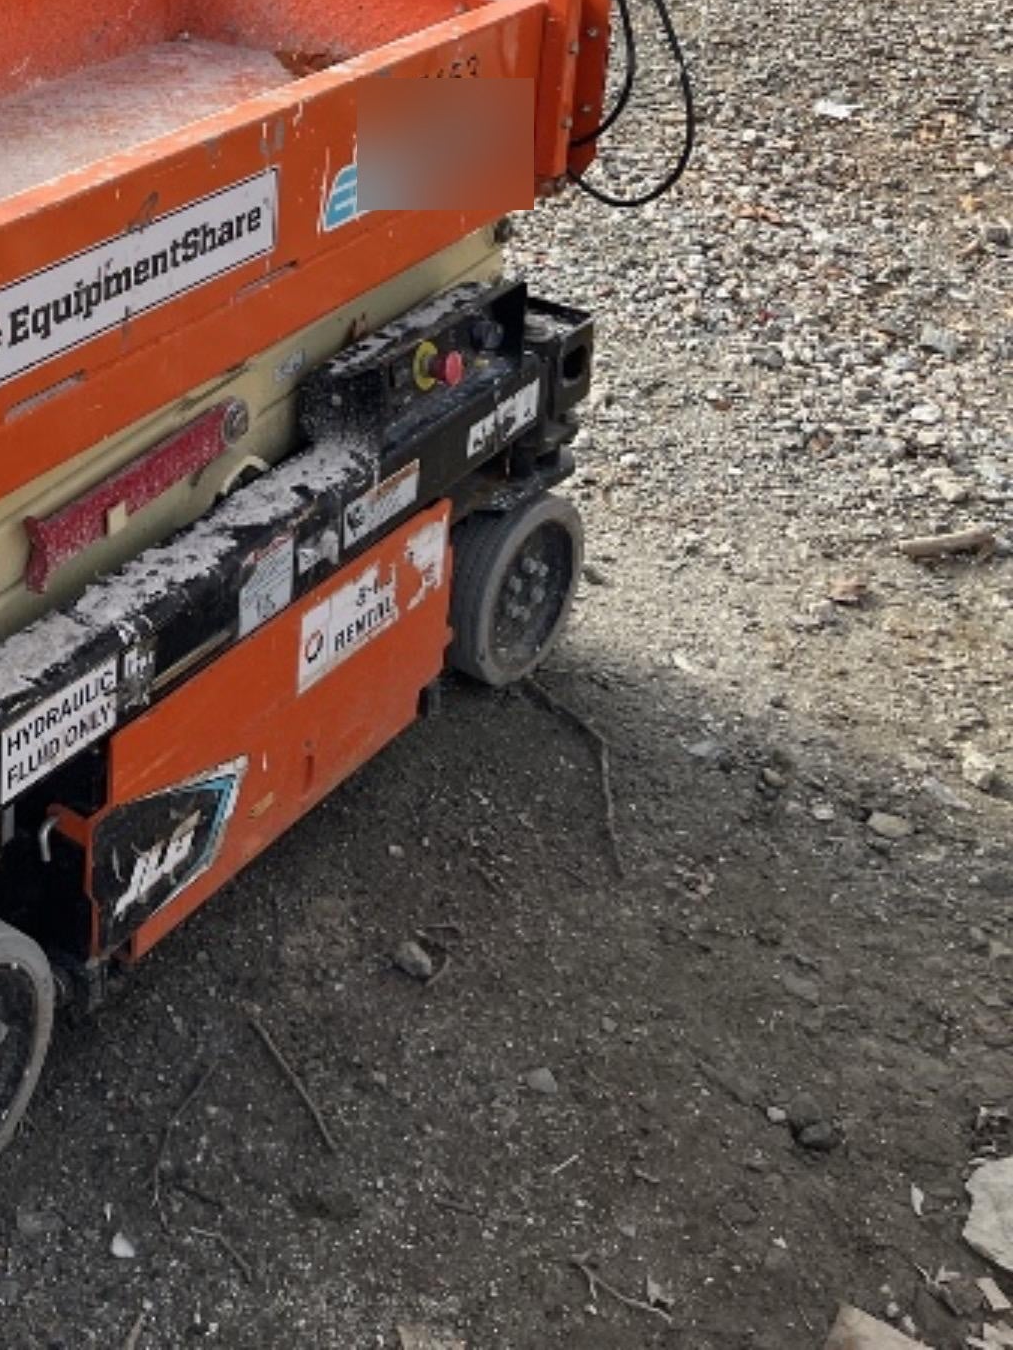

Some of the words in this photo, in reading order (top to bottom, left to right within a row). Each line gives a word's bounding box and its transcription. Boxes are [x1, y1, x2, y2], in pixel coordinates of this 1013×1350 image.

[7, 205, 262, 348] EquipmentShare
[7, 670, 114, 757] HYDRAULIC
[7, 737, 60, 790] FLUID
[64, 701, 111, 748] ONLY
